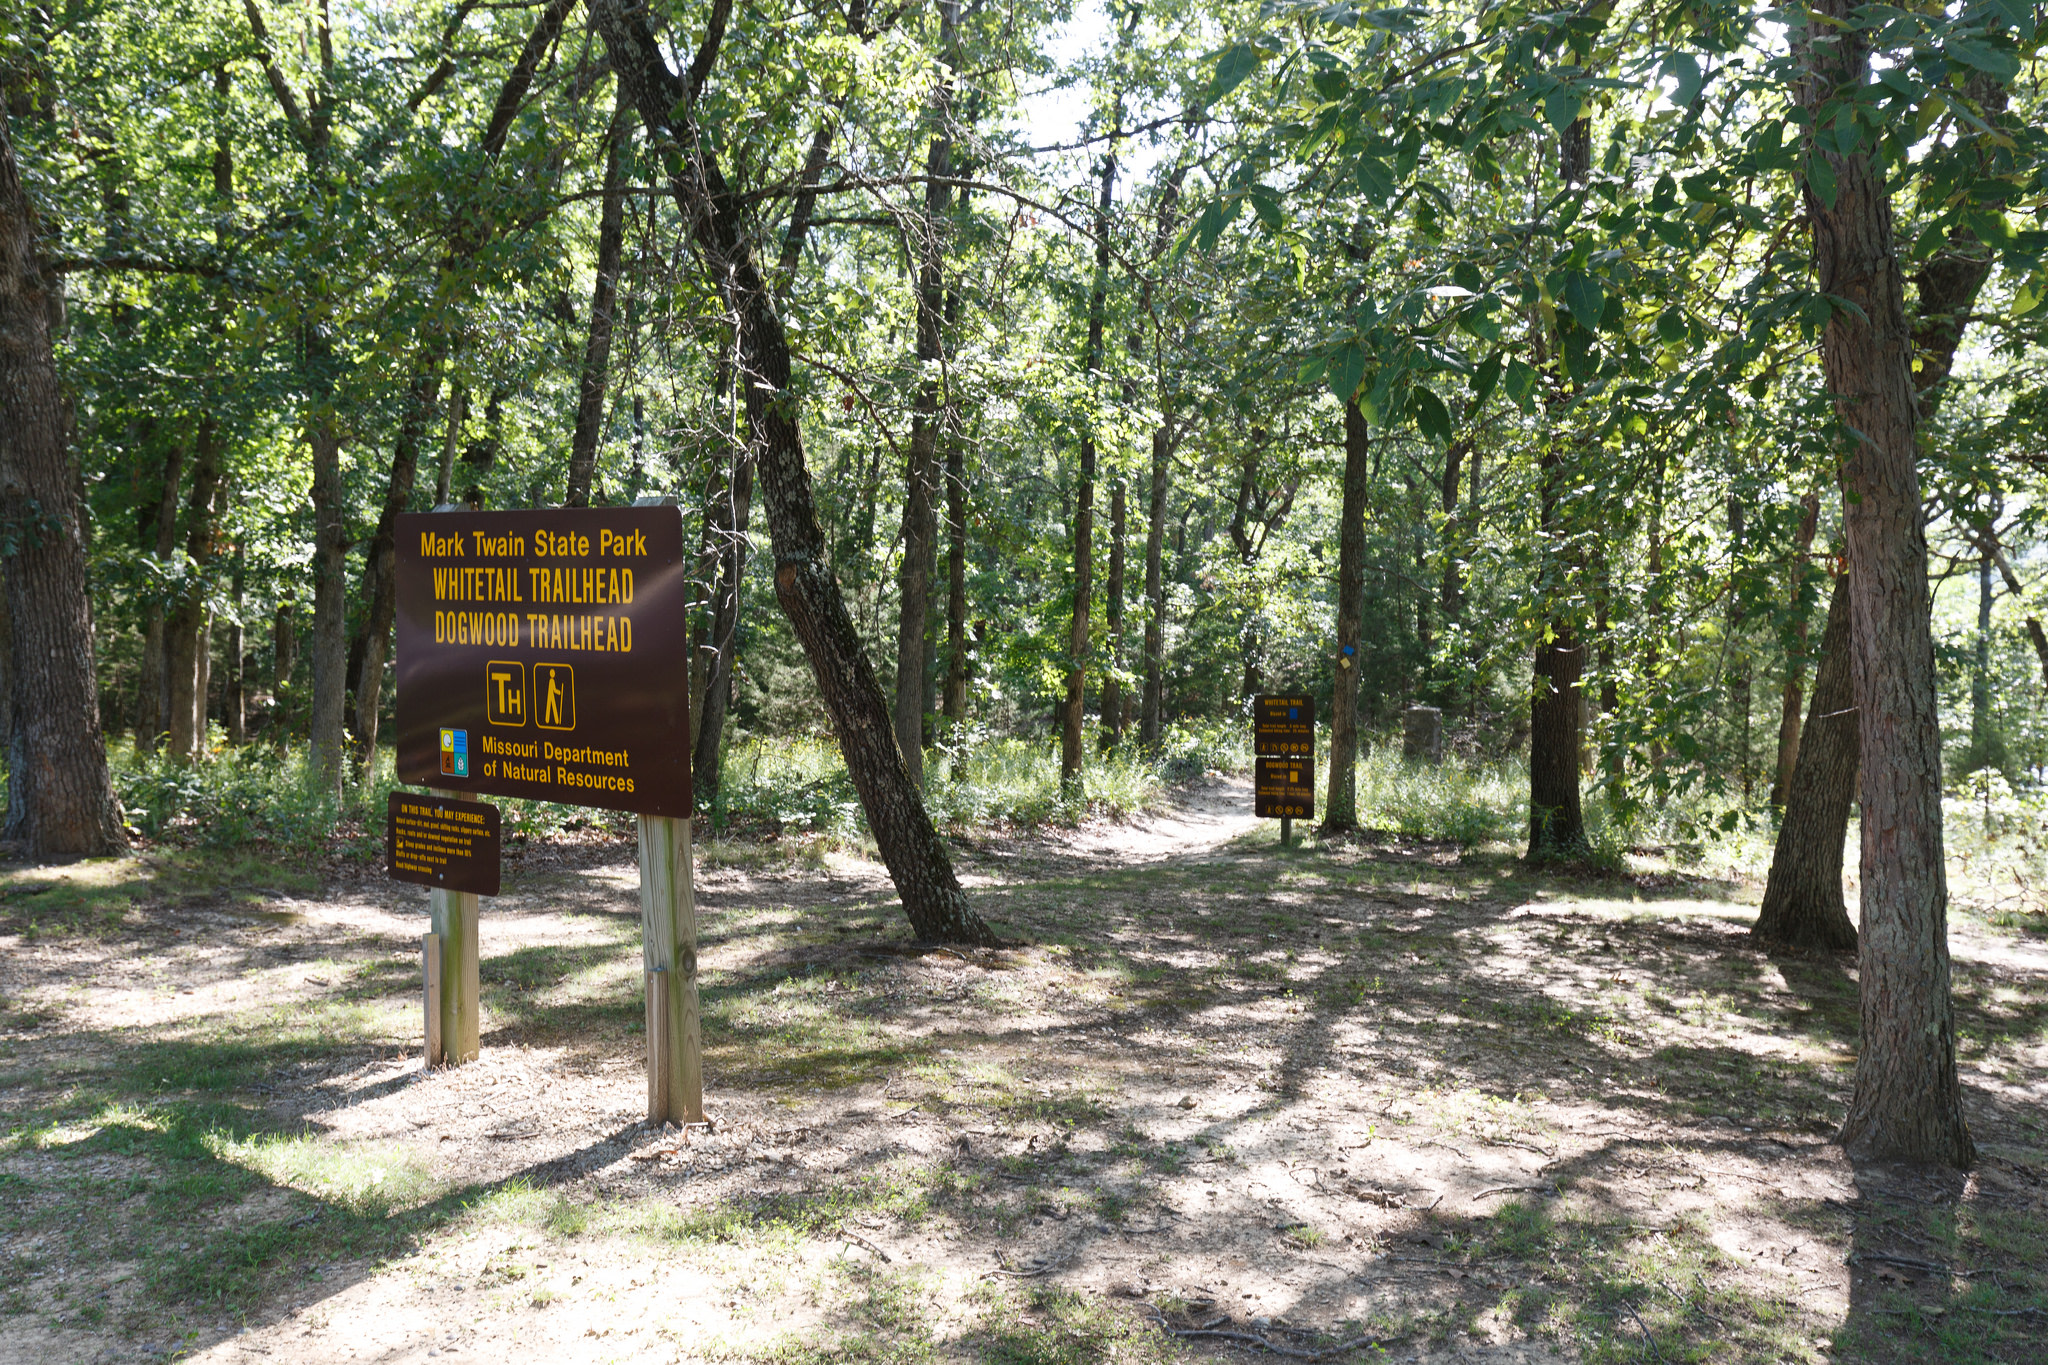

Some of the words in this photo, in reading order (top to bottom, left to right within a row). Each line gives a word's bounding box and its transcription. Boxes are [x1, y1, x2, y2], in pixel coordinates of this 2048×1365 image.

[421, 531, 464, 557] Mark
[473, 530, 525, 557] Twain
[534, 529, 590, 557] State
[600, 528, 648, 556] Park
[433, 567, 523, 602] WHITETAIL
[529, 567, 634, 604] TRAILHEAD
[435, 611, 519, 647] DOGWOOD
[527, 614, 632, 652] TRAILHEAD
[482, 735, 538, 759] Missouri
[543, 741, 630, 768] Department
[483, 762, 498, 778] of
[503, 764, 551, 784] Natural
[556, 766, 636, 793] Resources
[401, 804, 408, 813] ON
[408, 804, 419, 815] THIS
[434, 808, 443, 819] YOU
[444, 810, 454, 820] MAY
[455, 811, 485, 825] EXPERIENCE:
